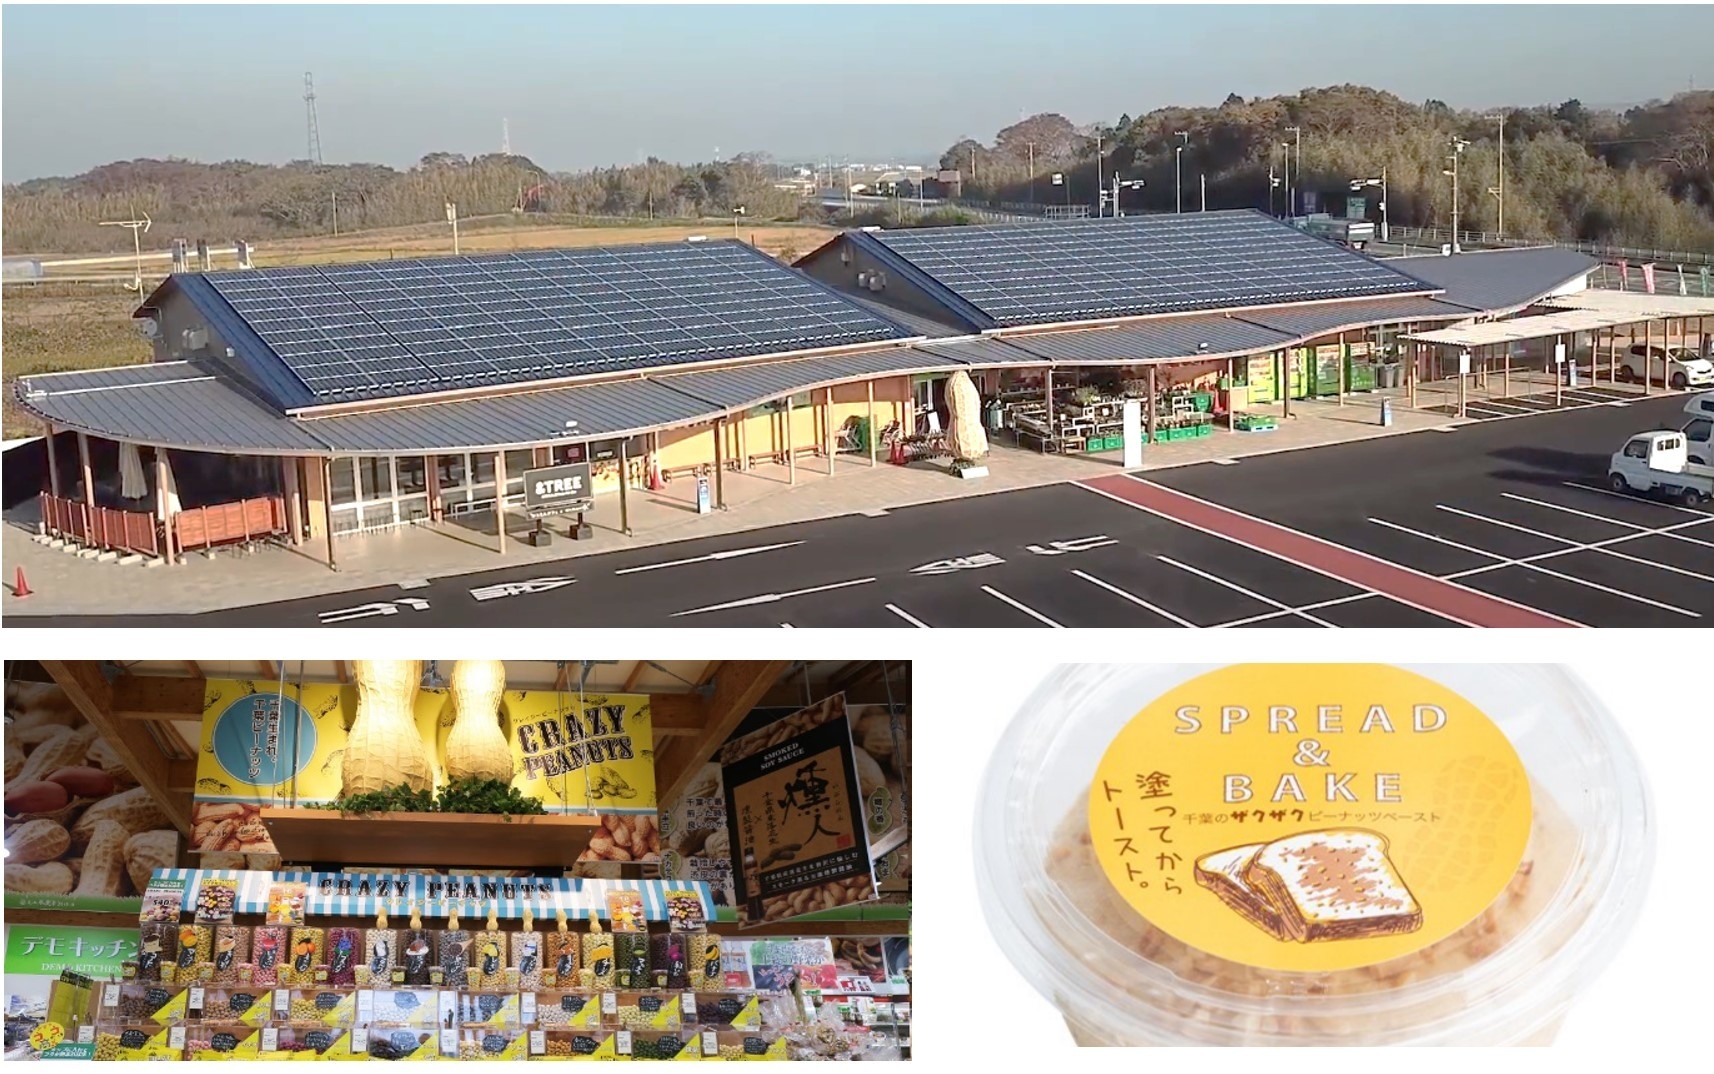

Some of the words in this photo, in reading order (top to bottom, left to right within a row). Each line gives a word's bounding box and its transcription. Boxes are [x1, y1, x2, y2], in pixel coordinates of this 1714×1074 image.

[535, 475, 582, 495] &TREE
[517, 704, 626, 754] CRAZY
[1174, 703, 1447, 734] SPREAD
[523, 736, 634, 780] PEANUTS
[760, 758, 778, 771] SOY
[778, 748, 805, 765] SAUCE
[763, 742, 799, 761] SMOKED
[1292, 738, 1330, 766] &
[1223, 772, 1402, 803] BAKE
[1102, 780, 1149, 889] トースト。
[1136, 771, 1183, 895] 塗ってから
[318, 878, 411, 898] CRAZY
[426, 880, 553, 900] PEANUTS
[21, 936, 138, 959] デモキッチン
